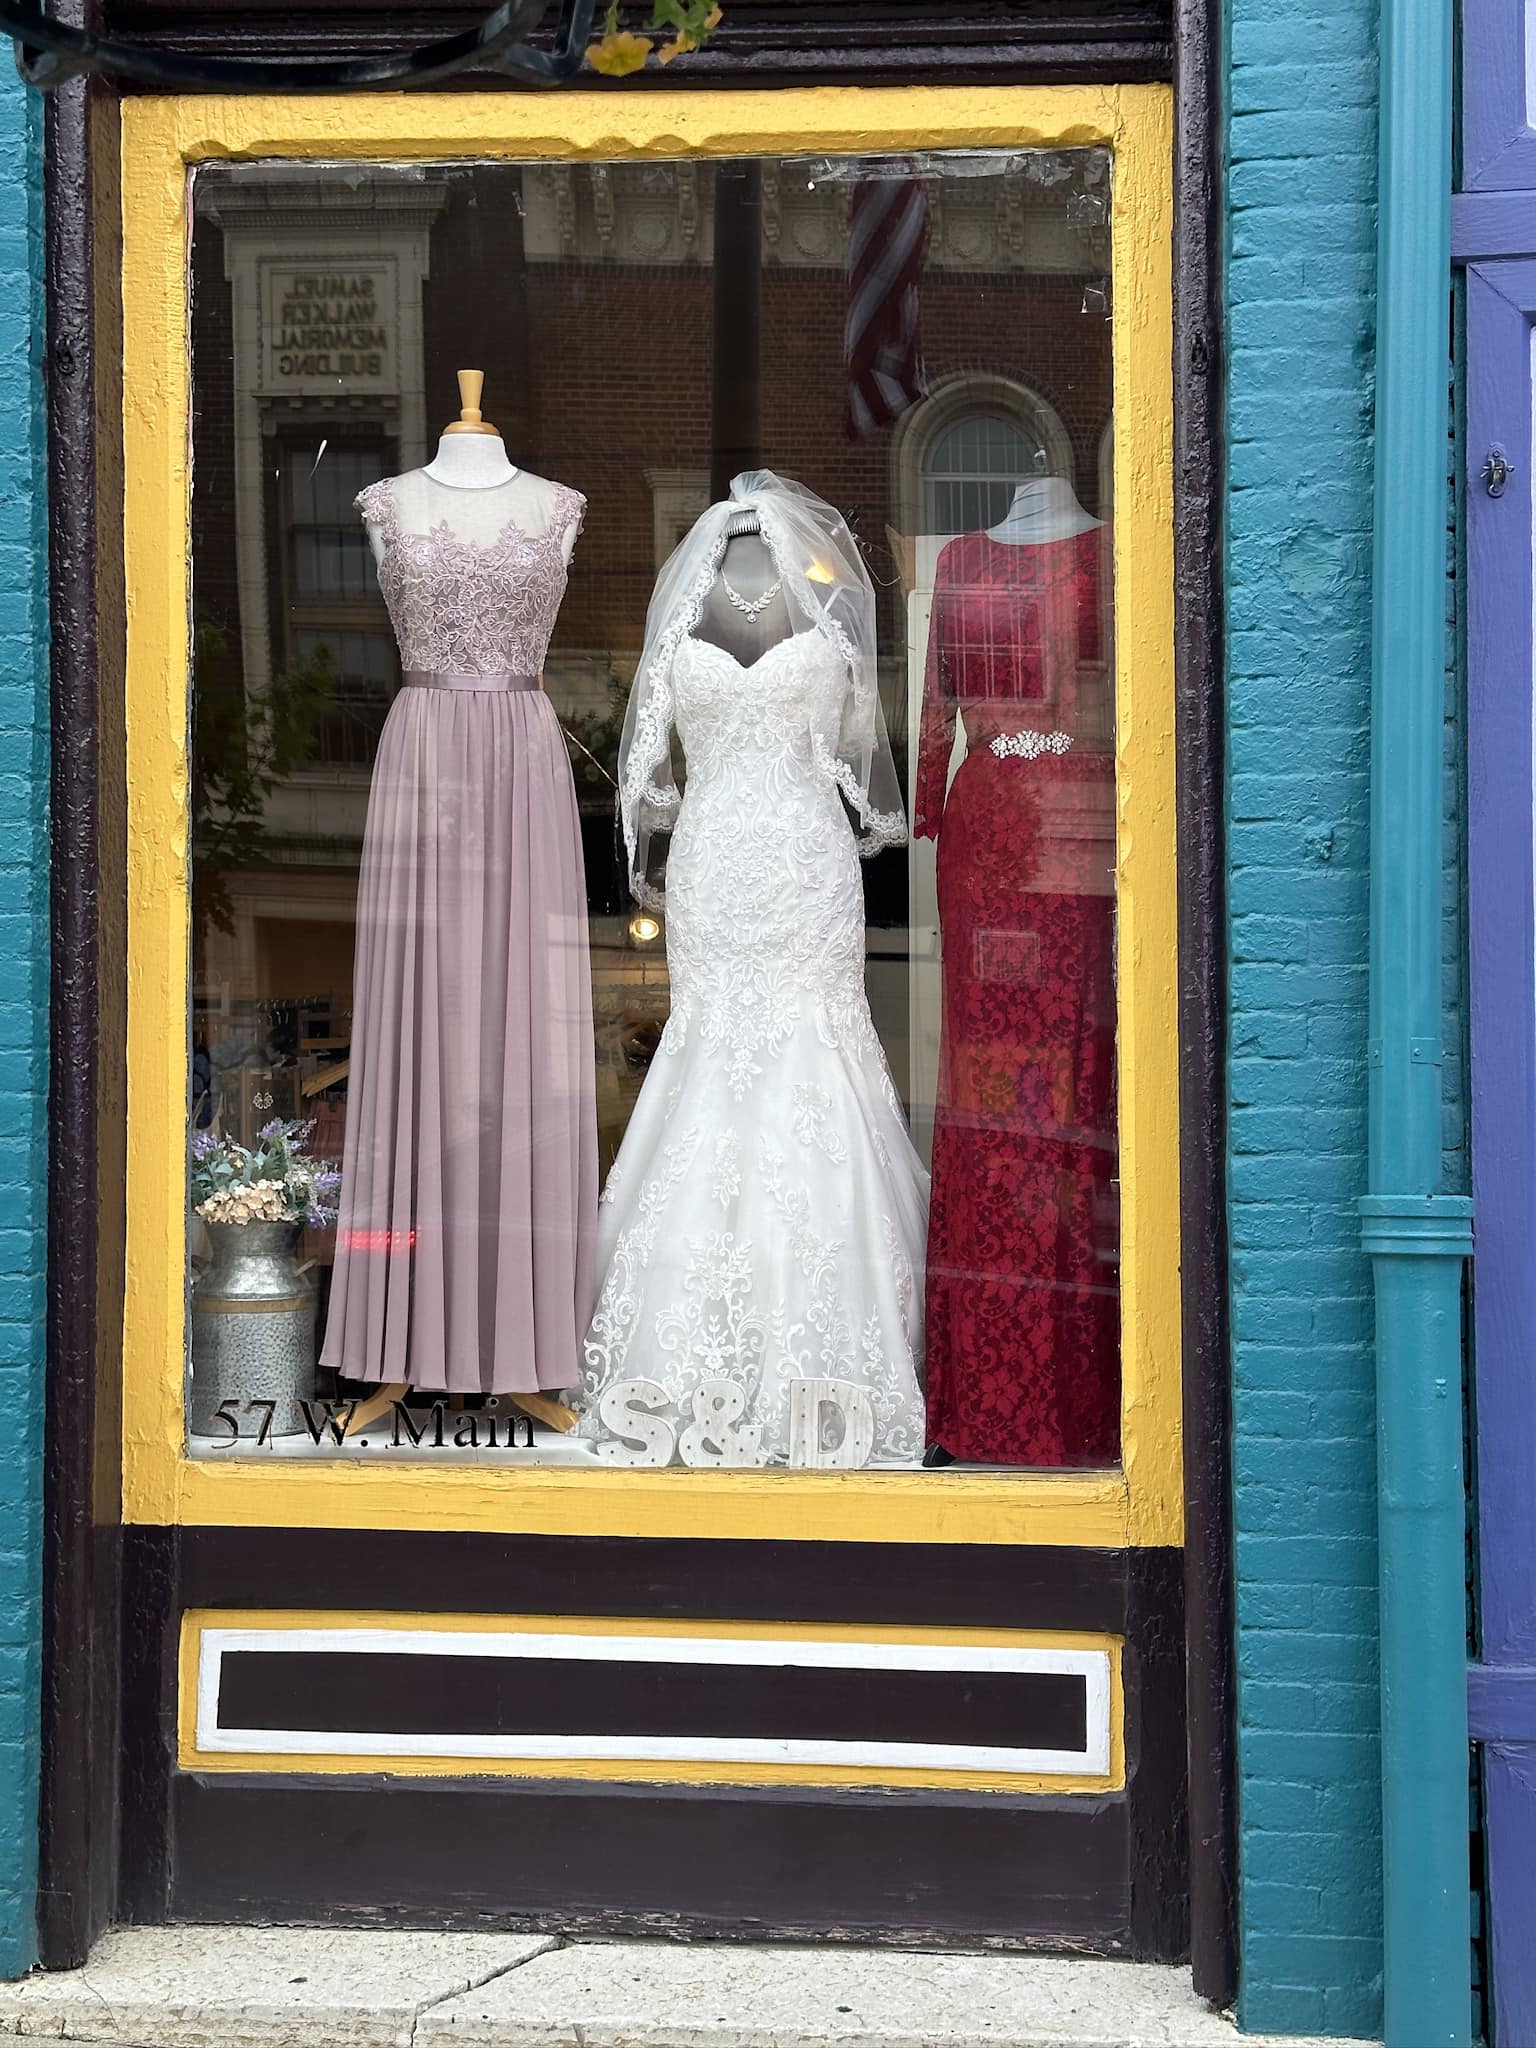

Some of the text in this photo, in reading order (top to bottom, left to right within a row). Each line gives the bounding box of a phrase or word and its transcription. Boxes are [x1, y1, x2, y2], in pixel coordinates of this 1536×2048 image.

[209, 1397, 534, 1449] 57 W. Main
